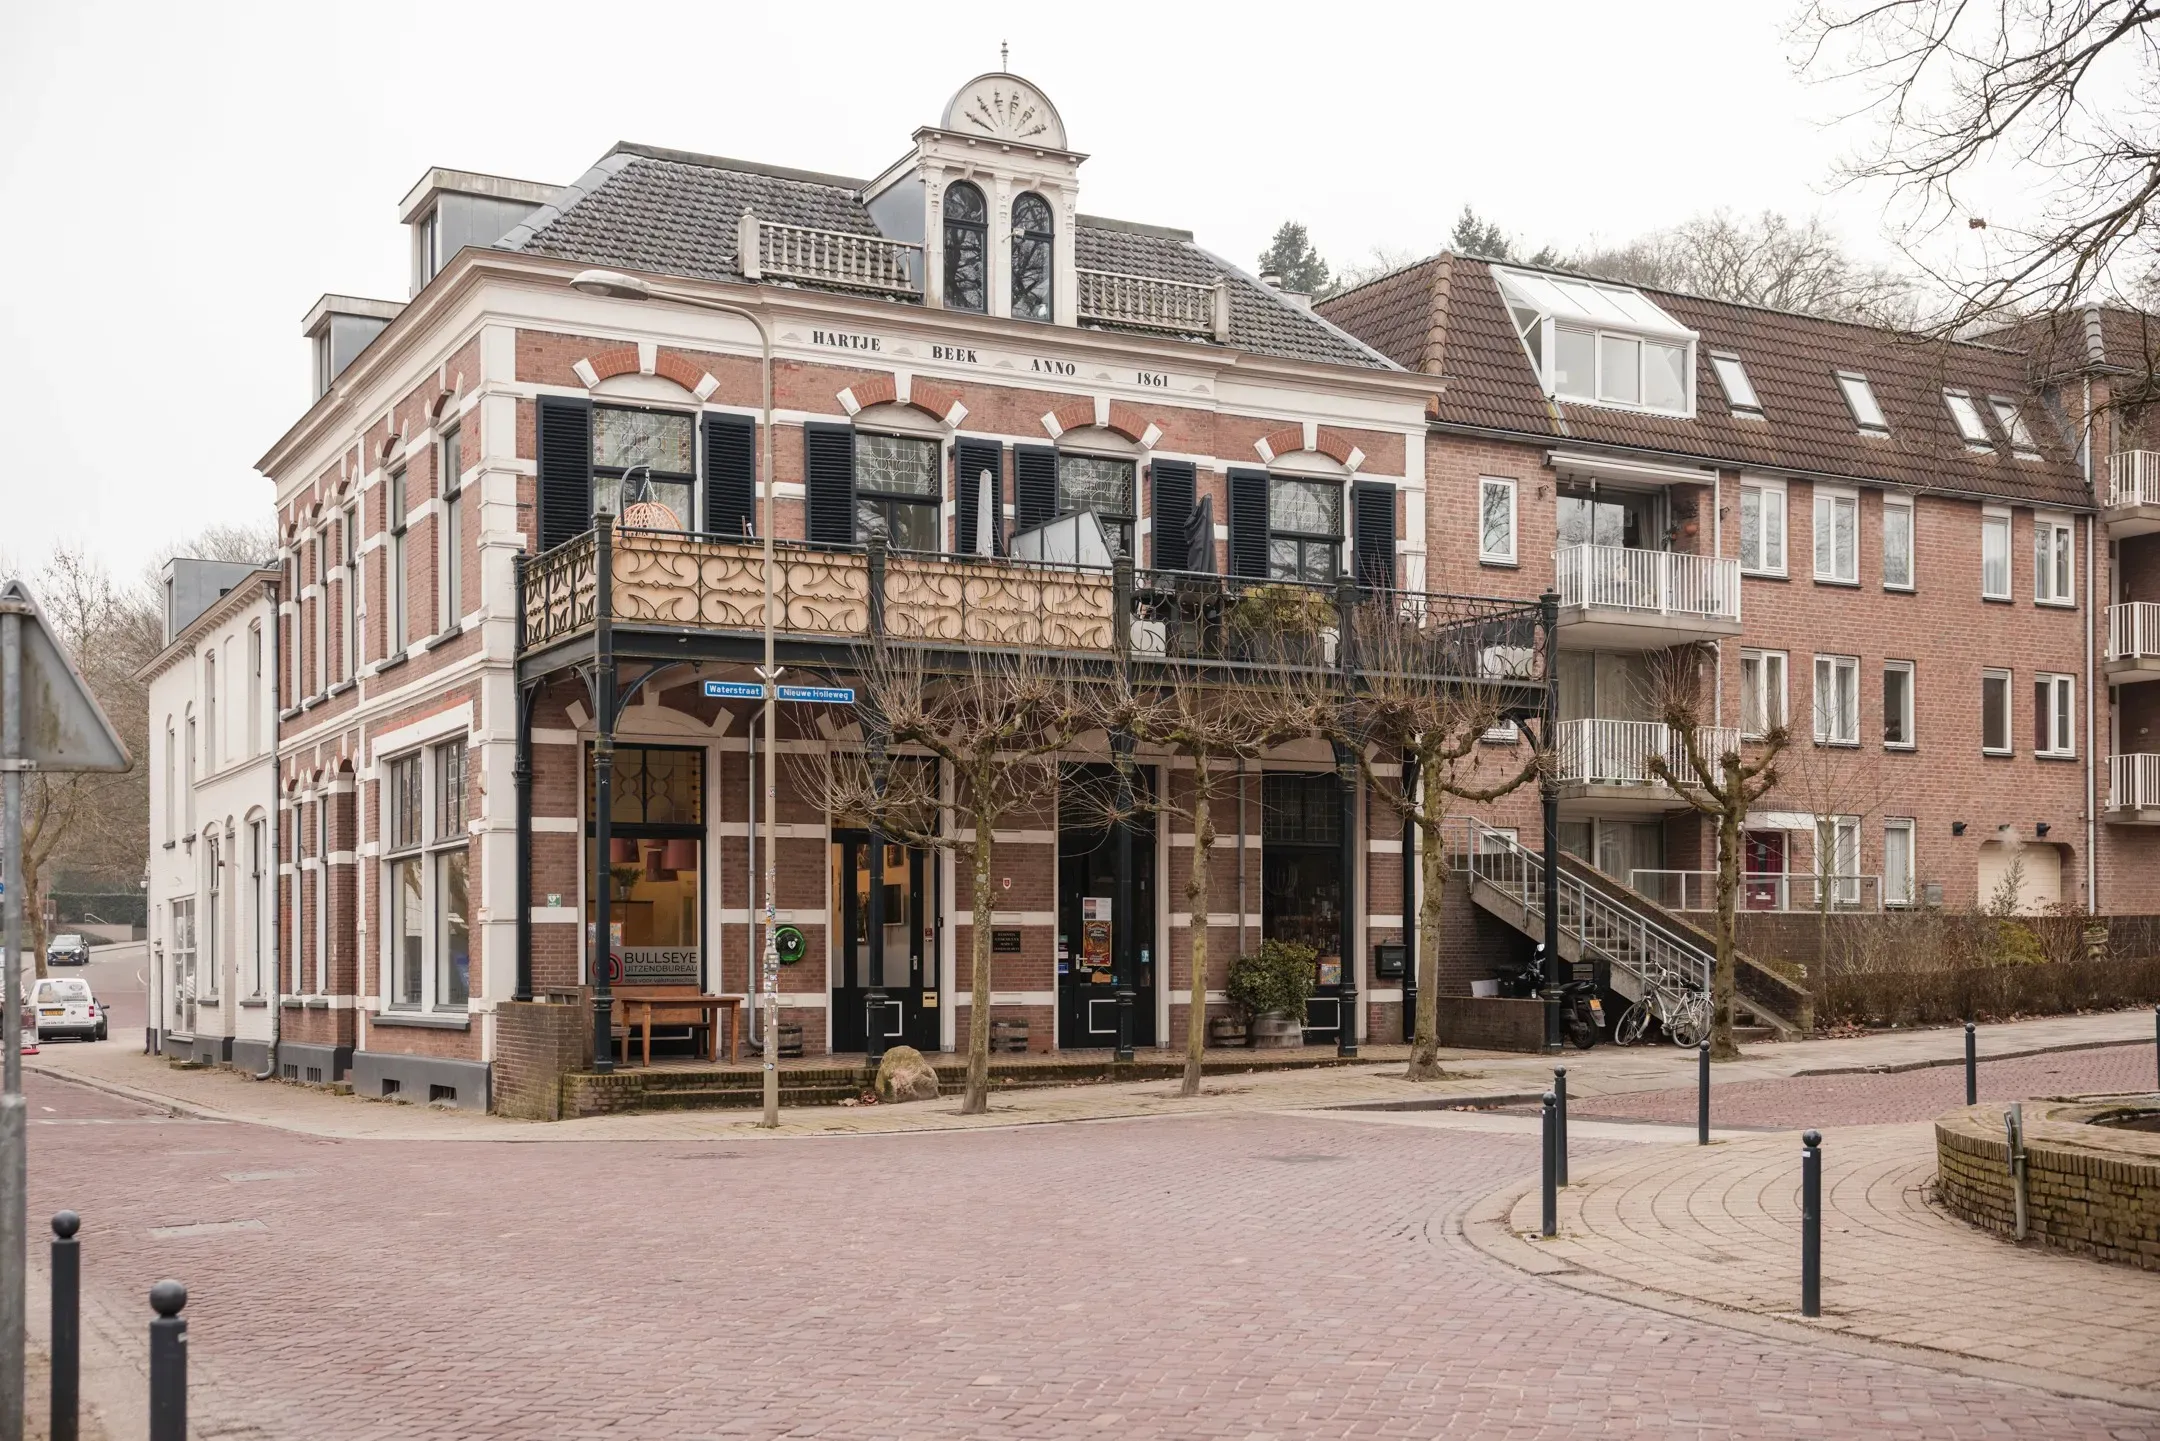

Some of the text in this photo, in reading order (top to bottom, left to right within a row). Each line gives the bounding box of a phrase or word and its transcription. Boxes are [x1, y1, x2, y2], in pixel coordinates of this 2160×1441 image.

[813, 330, 1168, 387] HARTJE BEEK ANNO 1861
[709, 685, 760, 695] Waterstraat
[783, 688, 811, 697] Nieuwe
[624, 952, 697, 964] BULLSEYE
[624, 965, 698, 973] UITZENDBUREAU
